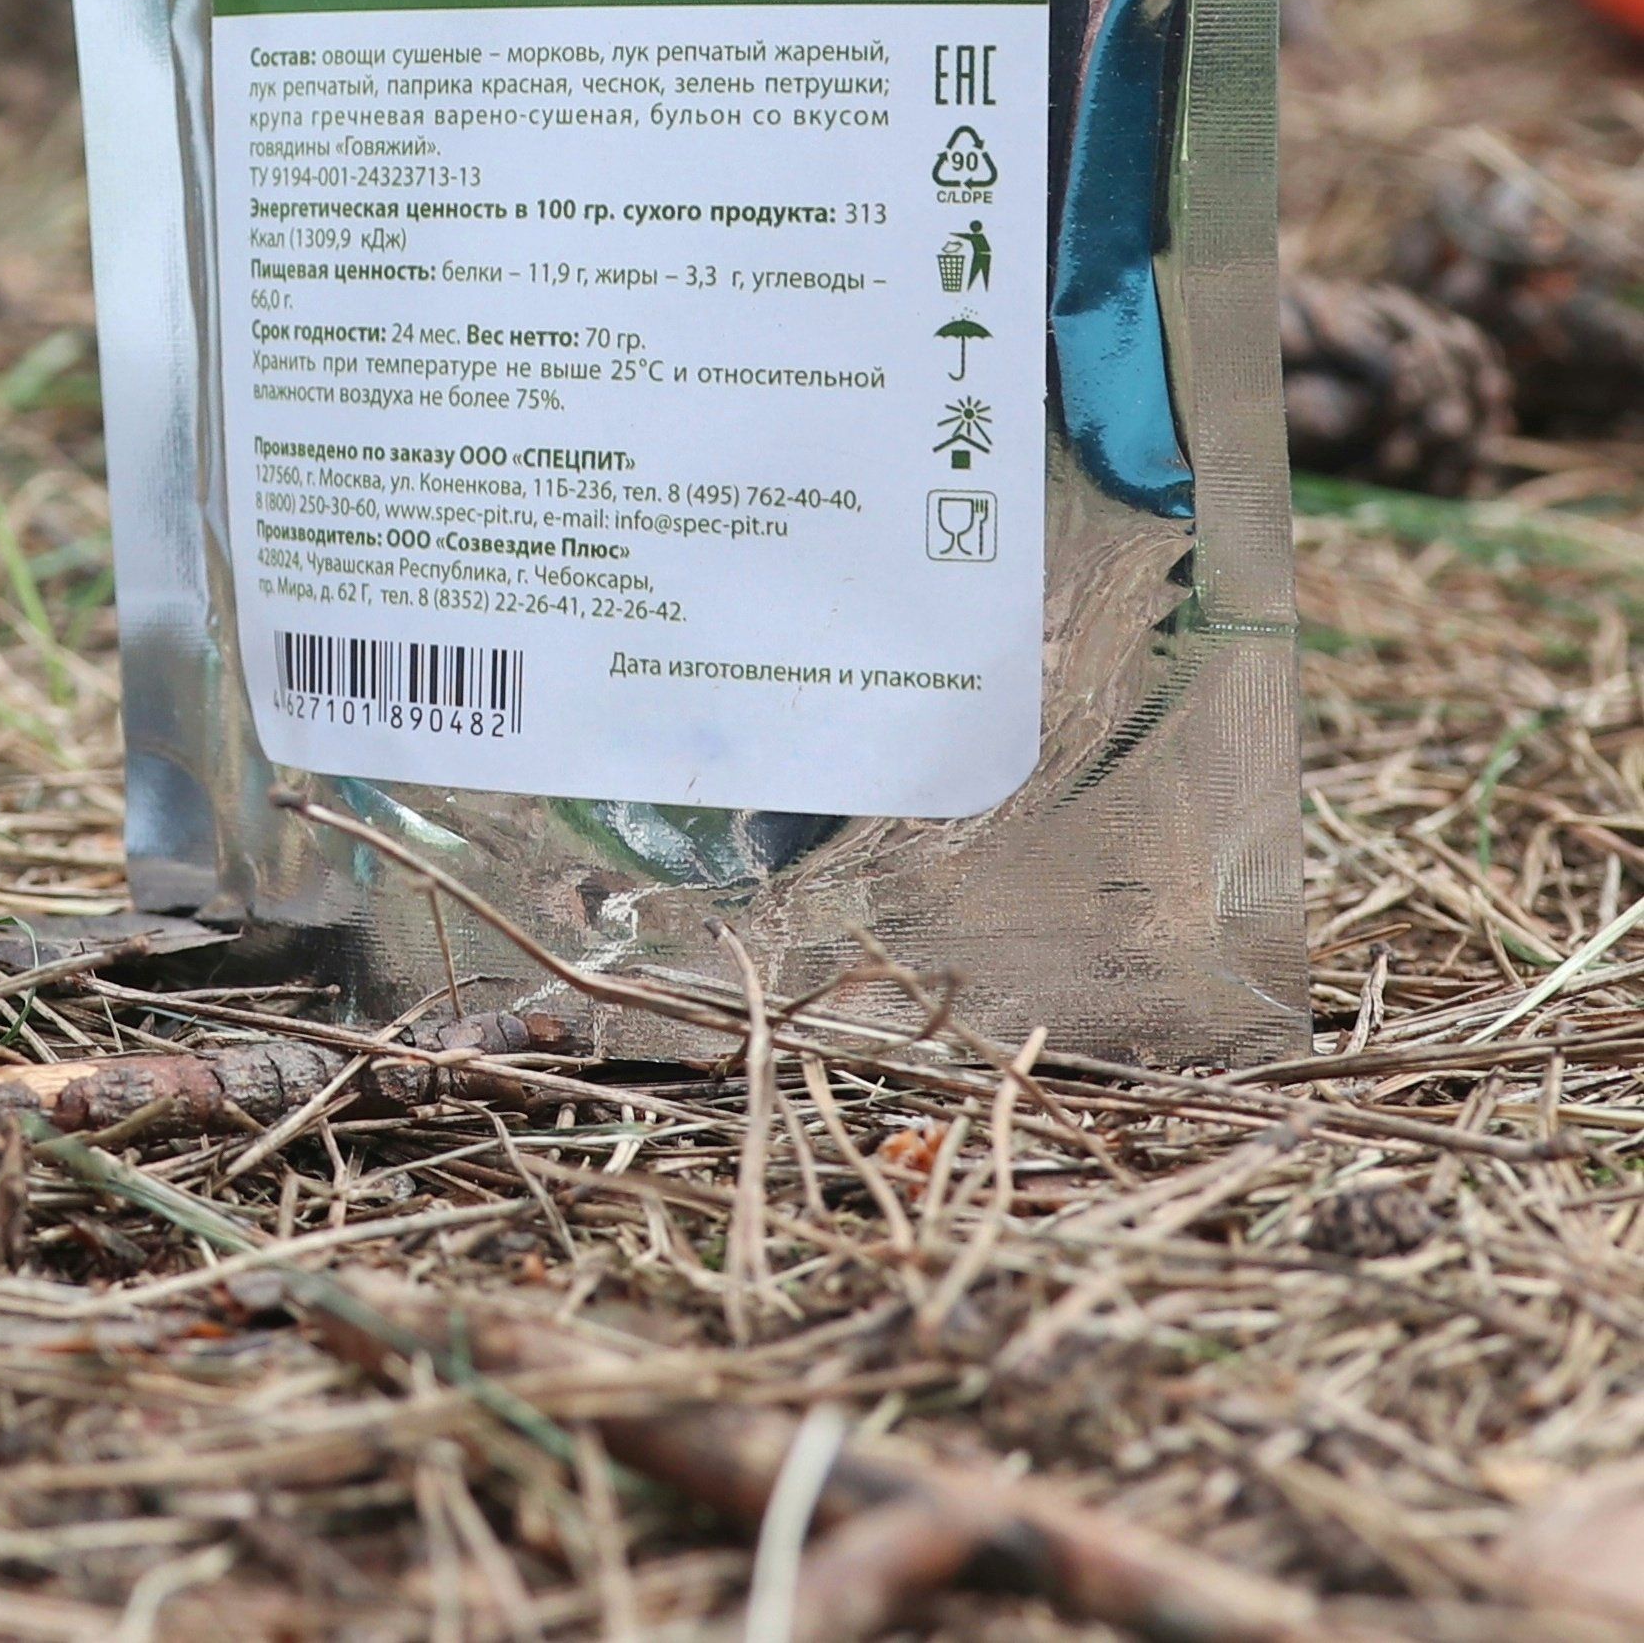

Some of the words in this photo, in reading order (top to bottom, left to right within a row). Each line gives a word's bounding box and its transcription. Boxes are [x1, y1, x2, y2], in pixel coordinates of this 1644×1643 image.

[251, 47, 316, 67] Состав:
[322, 49, 385, 68] овощи
[393, 48, 482, 69] сушеные
[508, 46, 604, 67] морковь,
[612, 46, 649, 67] лук
[657, 40, 766, 67] репчатый
[775, 40, 889, 66] жареный,
[249, 82, 276, 103] лук
[283, 74, 378, 101] репчатый,
[388, 79, 472, 100] паприка
[482, 78, 572, 99] красная,
[583, 77, 664, 96] чеснок,
[675, 77, 754, 93] зелень
[766, 77, 889, 99] петрушки;
[250, 111, 302, 133] крупа
[312, 109, 424, 131] гречневая
[435, 109, 639, 130] варено-сушеная,
[651, 102, 740, 130] бульон
[753, 109, 781, 125] со
[794, 109, 888, 131] вкусом
[250, 141, 330, 160] говядины
[336, 135, 440, 156] «Говяжий».
[952, 151, 978, 171] 90
[249, 166, 268, 187] ТУ
[272, 166, 480, 187] 9194-001-24323713-13
[250, 198, 399, 223] Энергетическая
[407, 202, 507, 222] ценность
[516, 203, 527, 219] в
[538, 199, 576, 219] 100
[584, 204, 615, 225] гр.
[623, 204, 701, 226] сухого
[711, 206, 835, 228] продукта:
[845, 202, 886, 224] 313
[937, 191, 992, 204] C/LDPE
[250, 227, 284, 248] Ккал
[290, 228, 351, 250] (1309,9
[361, 228, 406, 253] кДж)
[251, 258, 328, 283] Пищевая
[335, 264, 436, 283] ценность:
[442, 260, 502, 282] белки
[530, 263, 570, 286] 11,9
[577, 268, 588, 287] г,
[595, 269, 657, 290] жиры
[686, 265, 716, 289] 3,3
[732, 271, 744, 290] г,
[752, 272, 864, 293] углеводы
[251, 289, 280, 311] 66,0
[284, 294, 293, 309] г.
[252, 319, 290, 345] Срок
[294, 325, 386, 345] годности:
[392, 323, 414, 343] 24
[420, 328, 460, 345] мес.
[467, 324, 503, 345] Вес
[510, 330, 579, 347] нетто:
[586, 327, 610, 348] 70
[617, 333, 645, 354] гр.
[253, 350, 316, 374] Хранить
[323, 356, 357, 377] при
[366, 358, 497, 381] температуре
[507, 362, 531, 378] не
[541, 363, 601, 379] выше
[674, 367, 687, 382] и
[698, 367, 884, 389] относительной
[253, 384, 334, 402] влажности
[340, 387, 413, 410] воздуха
[420, 390, 443, 406] не
[449, 385, 509, 408] более
[517, 388, 564, 411] 75%.
[255, 436, 358, 462] Произведено
[363, 446, 385, 461] по
[390, 447, 455, 469] заказу
[460, 445, 507, 466] ООО
[513, 448, 635, 473] «СПЕЦПИТ»
[256, 464, 302, 487] 127560,
[307, 471, 315, 486] г.
[319, 467, 385, 492] Москва,
[391, 476, 414, 495] ул.
[420, 472, 526, 498] Коненкова,
[535, 478, 616, 503] 11Б-236,
[623, 486, 661, 502] тел.
[668, 483, 680, 503] 8
[687, 483, 739, 509] (495)
[747, 487, 861, 512] 762-40-40,
[256, 491, 263, 510] 8
[265, 492, 296, 514] (800)
[300, 494, 379, 520] 250-30-60,
[385, 504, 537, 528] www.spec-pit.ru,
[543, 508, 609, 529] e-mail:
[615, 509, 787, 539] info@spec-pit.ru
[257, 519, 382, 547] Производитель:
[387, 528, 431, 549] ООО
[436, 532, 556, 559] «Созвездие
[562, 537, 629, 559] Плюс»
[258, 547, 303, 571] 428024,
[307, 552, 394, 576] Чувашская
[400, 557, 511, 585] Республика,
[518, 569, 528, 584] г.
[535, 565, 653, 594] Чебоксары,
[259, 578, 275, 598] пр.
[278, 576, 317, 602] Мира,
[320, 585, 334, 603] д.
[338, 582, 356, 602] 62
[362, 583, 372, 605] Г,
[380, 589, 413, 605] тел.
[419, 588, 428, 607] 8
[434, 588, 489, 613] (8352)
[495, 592, 585, 618] 22-26-41,
[592, 597, 686, 621] 22-26-42.
[610, 652, 661, 678] Дата
[669, 661, 831, 684] изготовления
[839, 669, 852, 685] и
[861, 670, 981, 691] упаковки:
